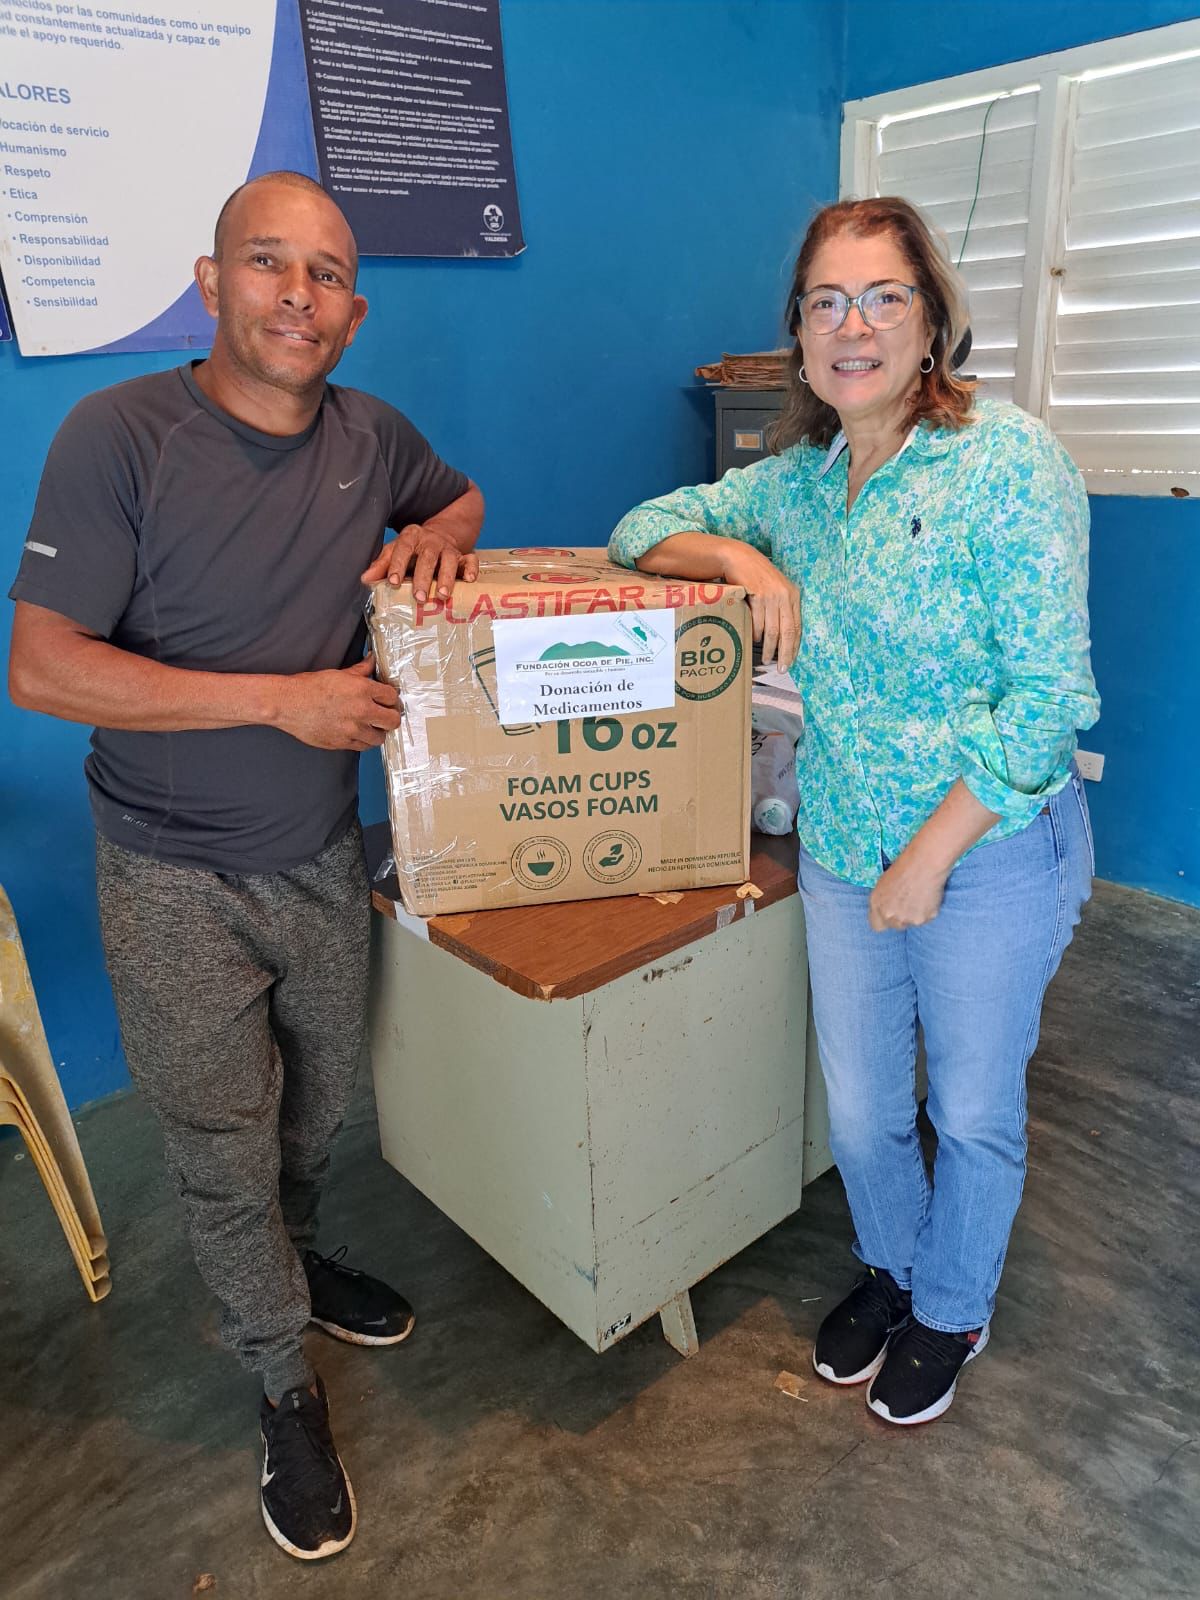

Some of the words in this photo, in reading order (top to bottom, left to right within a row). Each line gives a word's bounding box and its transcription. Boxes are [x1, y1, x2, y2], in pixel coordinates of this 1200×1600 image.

[56, 4, 74, 15] por
[77, 5, 93, 17] las
[96, 9, 167, 27] comunidades
[170, 18, 198, 31] como
[201, 21, 214, 32] un
[216, 23, 251, 36] equipo
[15, 13, 103, 33] constantemente
[105, 23, 164, 41] actualizada
[167, 32, 173, 43] y
[176, 34, 205, 46] capaz
[208, 35, 221, 46] de
[20, 27, 30, 38] el
[33, 31, 67, 44] apoyo
[70, 34, 125, 51] requerido.
[0, 118, 47, 133] ocación
[50, 123, 63, 134] de
[66, 125, 109, 138] servicio
[0, 142, 67, 157] Humanismo
[4, 165, 51, 179] Respeto
[10, 188, 38, 200] Etica
[15, 211, 88, 225] Comprensión
[19, 234, 109, 247] Responsabilidad
[24, 255, 101, 268] Disponibilidad
[26, 276, 96, 288] Competencia
[33, 297, 98, 307] Sensibilidad
[680, 648, 725, 667] BIO
[516, 661, 570, 671] FUNDACIÓN
[680, 666, 726, 678] PACTO
[540, 681, 612, 697] Donación
[618, 679, 634, 691] de
[534, 699, 642, 717] Medicamentos
[557, 716, 624, 754] 16
[508, 774, 582, 797] FOAM
[589, 769, 651, 792] CUPS
[499, 799, 580, 822] VASOS
[587, 794, 658, 817] FOAM
